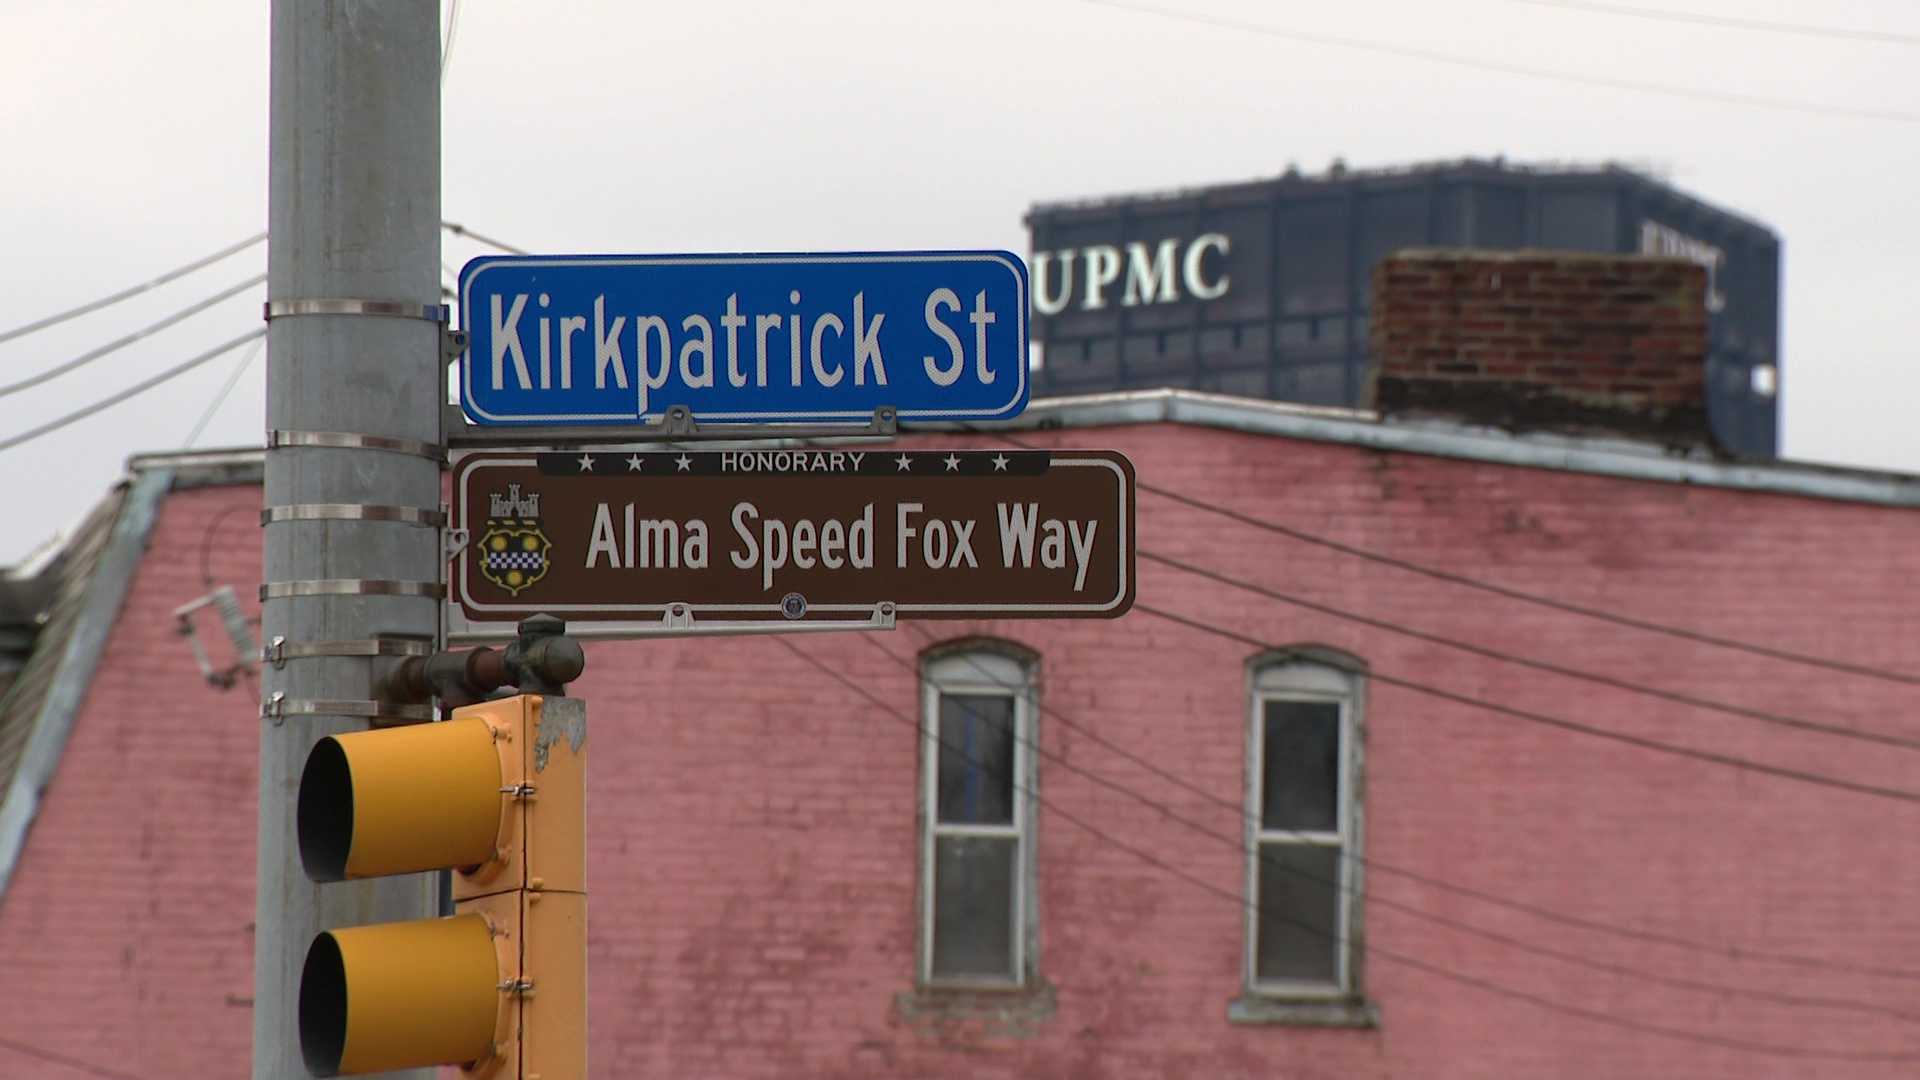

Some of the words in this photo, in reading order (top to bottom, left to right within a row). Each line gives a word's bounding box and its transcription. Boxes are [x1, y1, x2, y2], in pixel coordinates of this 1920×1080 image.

[1031, 232, 1231, 316] UPMC
[490, 290, 888, 417] Kirkpatrick
[923, 287, 997, 387] St
[721, 451, 865, 472] HONORARY
[585, 502, 708, 570] Alma
[730, 502, 873, 591] Speed
[897, 502, 979, 569] Fox
[997, 502, 1097, 592] Way
